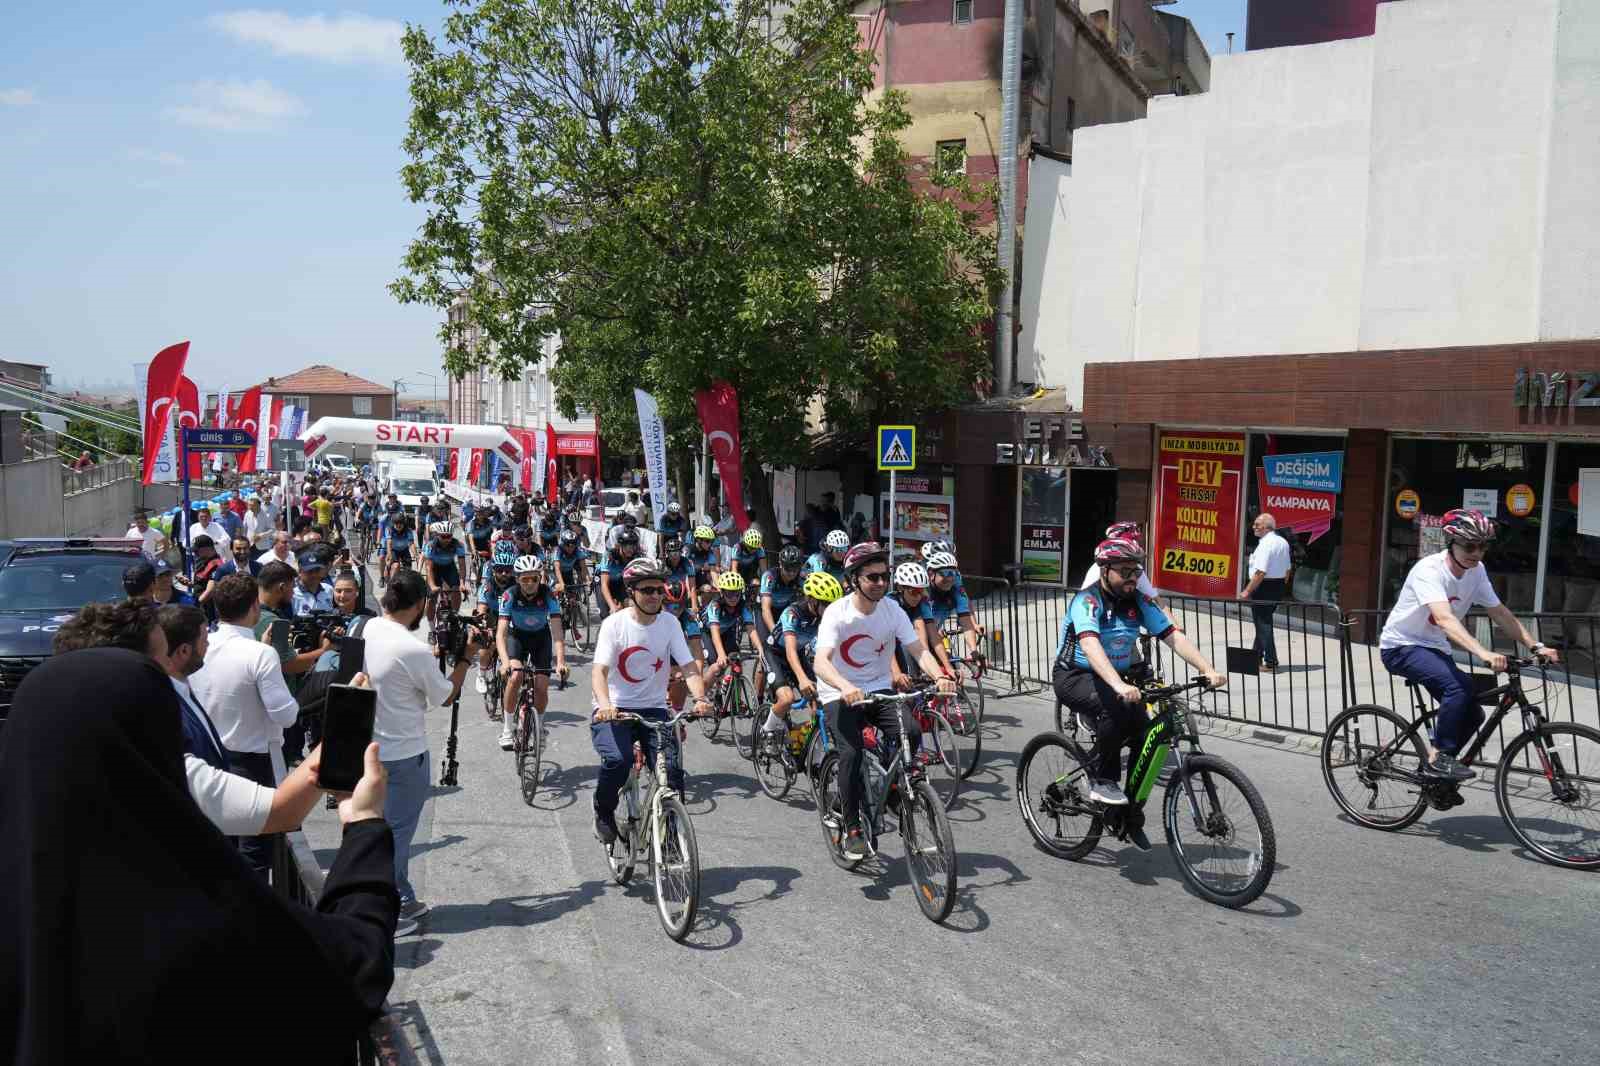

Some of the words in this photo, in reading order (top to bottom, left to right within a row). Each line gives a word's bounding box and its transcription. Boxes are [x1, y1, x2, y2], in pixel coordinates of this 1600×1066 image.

[376, 423, 454, 444] START
[1024, 418, 1084, 439] EFE
[996, 443, 1110, 466] EMLAK
[1183, 461, 1216, 486] DEV
[1276, 458, 1330, 478] DEĞİŞİM
[1180, 488, 1216, 502] FIRSAT
[1267, 495, 1331, 511] KAMPANYA
[1177, 507, 1218, 526] KOLTUK
[1032, 529, 1053, 538] EFE
[1177, 525, 1215, 544] TAKIMI
[1024, 539, 1061, 549] EMLAK
[1165, 551, 1214, 574] 24.900
